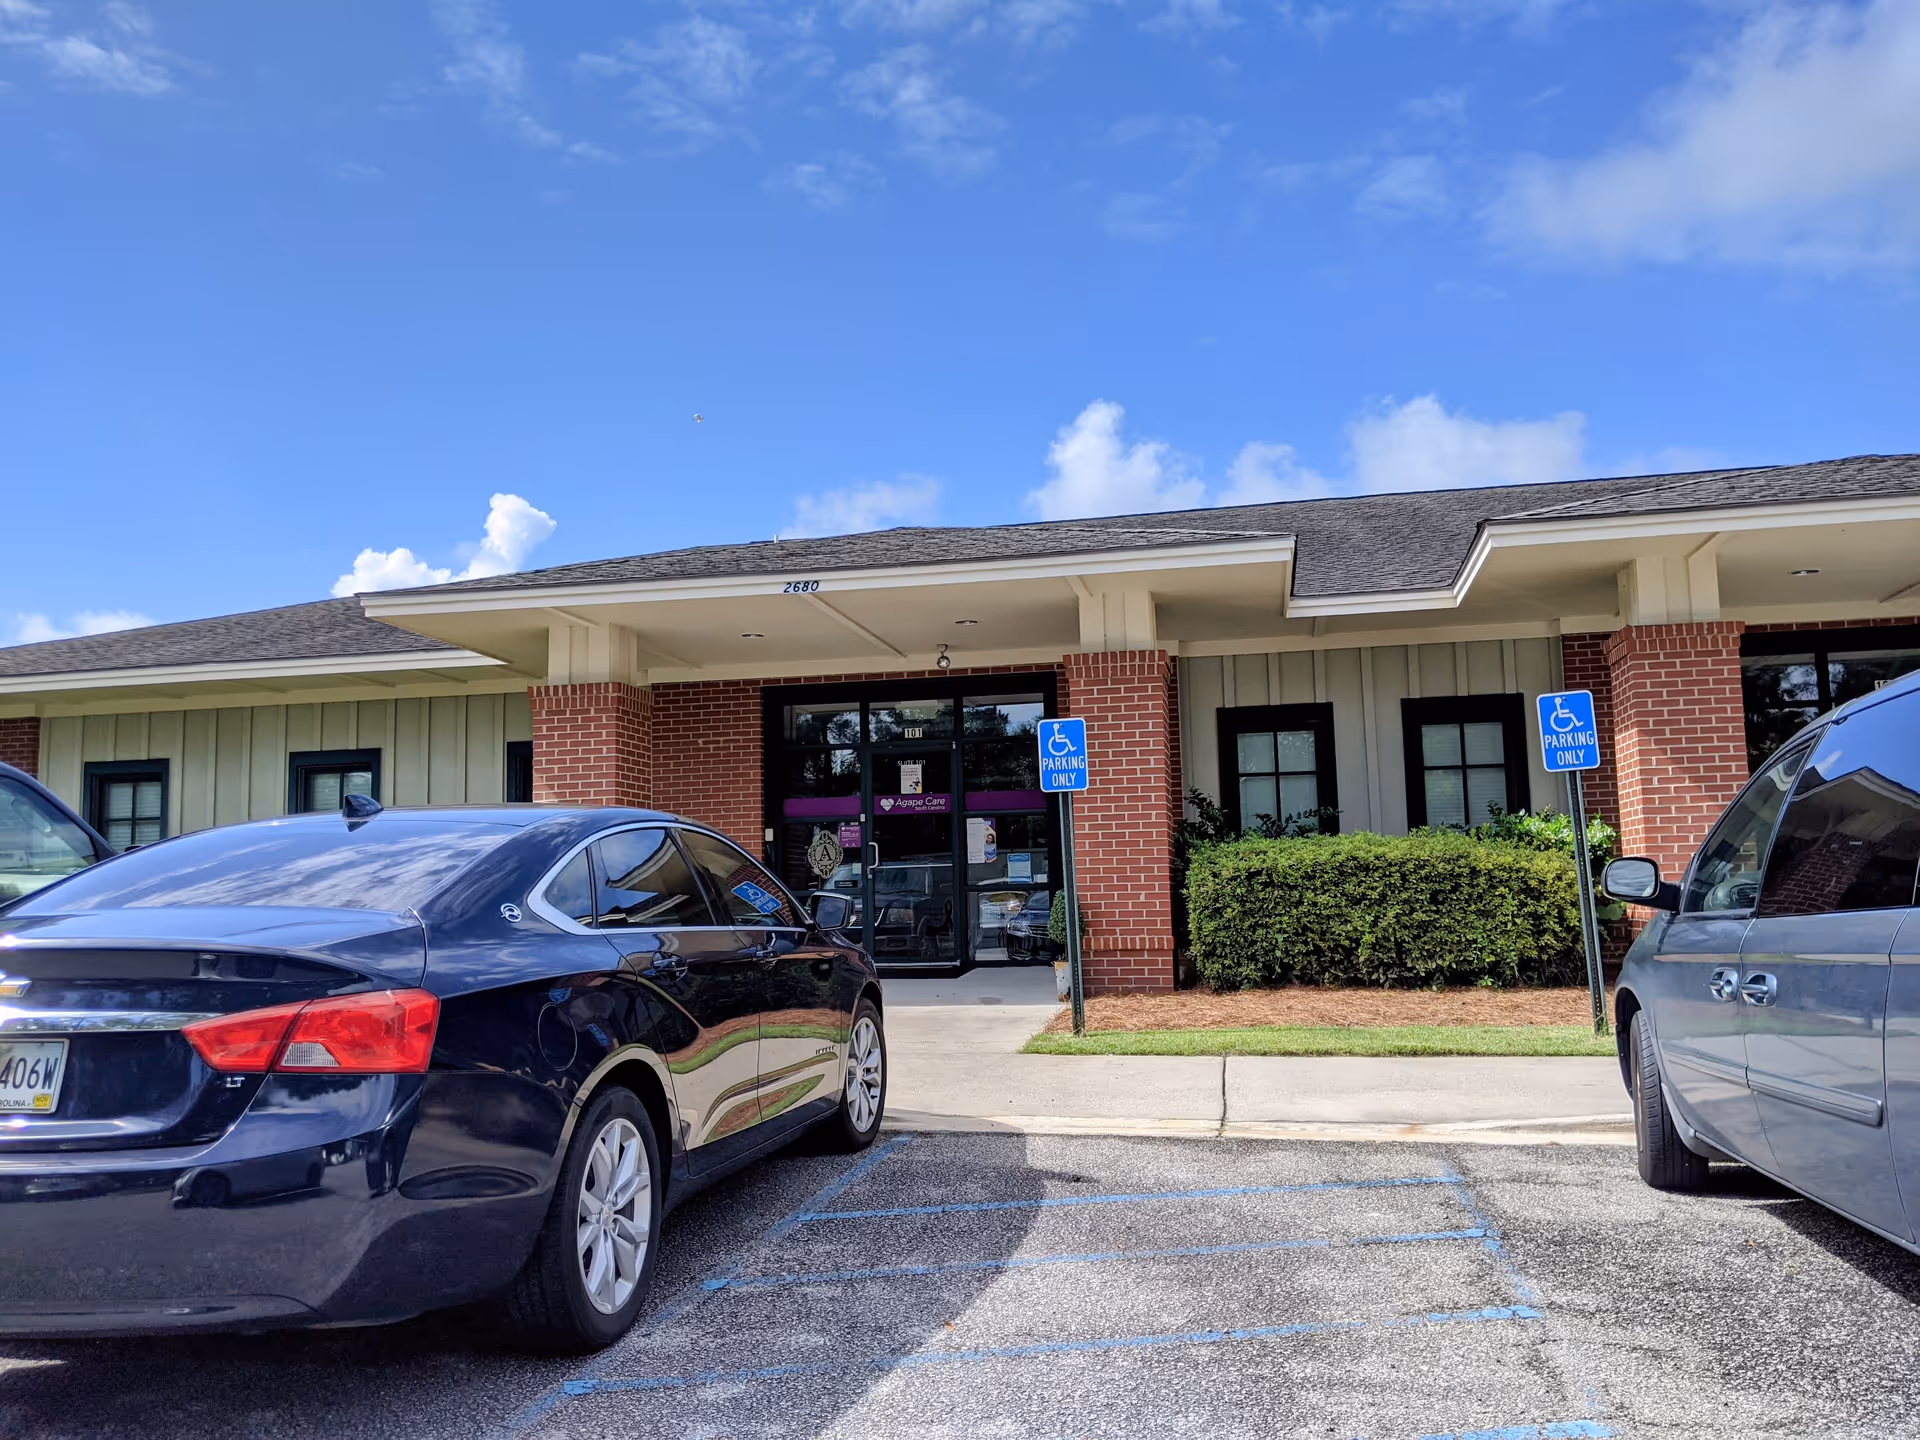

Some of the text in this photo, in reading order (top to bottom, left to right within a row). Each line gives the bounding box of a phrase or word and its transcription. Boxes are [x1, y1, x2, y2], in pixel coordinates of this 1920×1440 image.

[783, 580, 819, 593] 2680
[906, 729, 921, 737] 101
[1544, 730, 1594, 749] PARKING
[1042, 755, 1085, 771] PARKING
[1556, 749, 1585, 766] ONLY
[1052, 772, 1076, 787] ONLY
[895, 796, 946, 808] Agape Care
[0, 1056, 59, 1090] 406W
[226, 1077, 245, 1088] LT
[0, 1099, 26, 1107] OLINA
